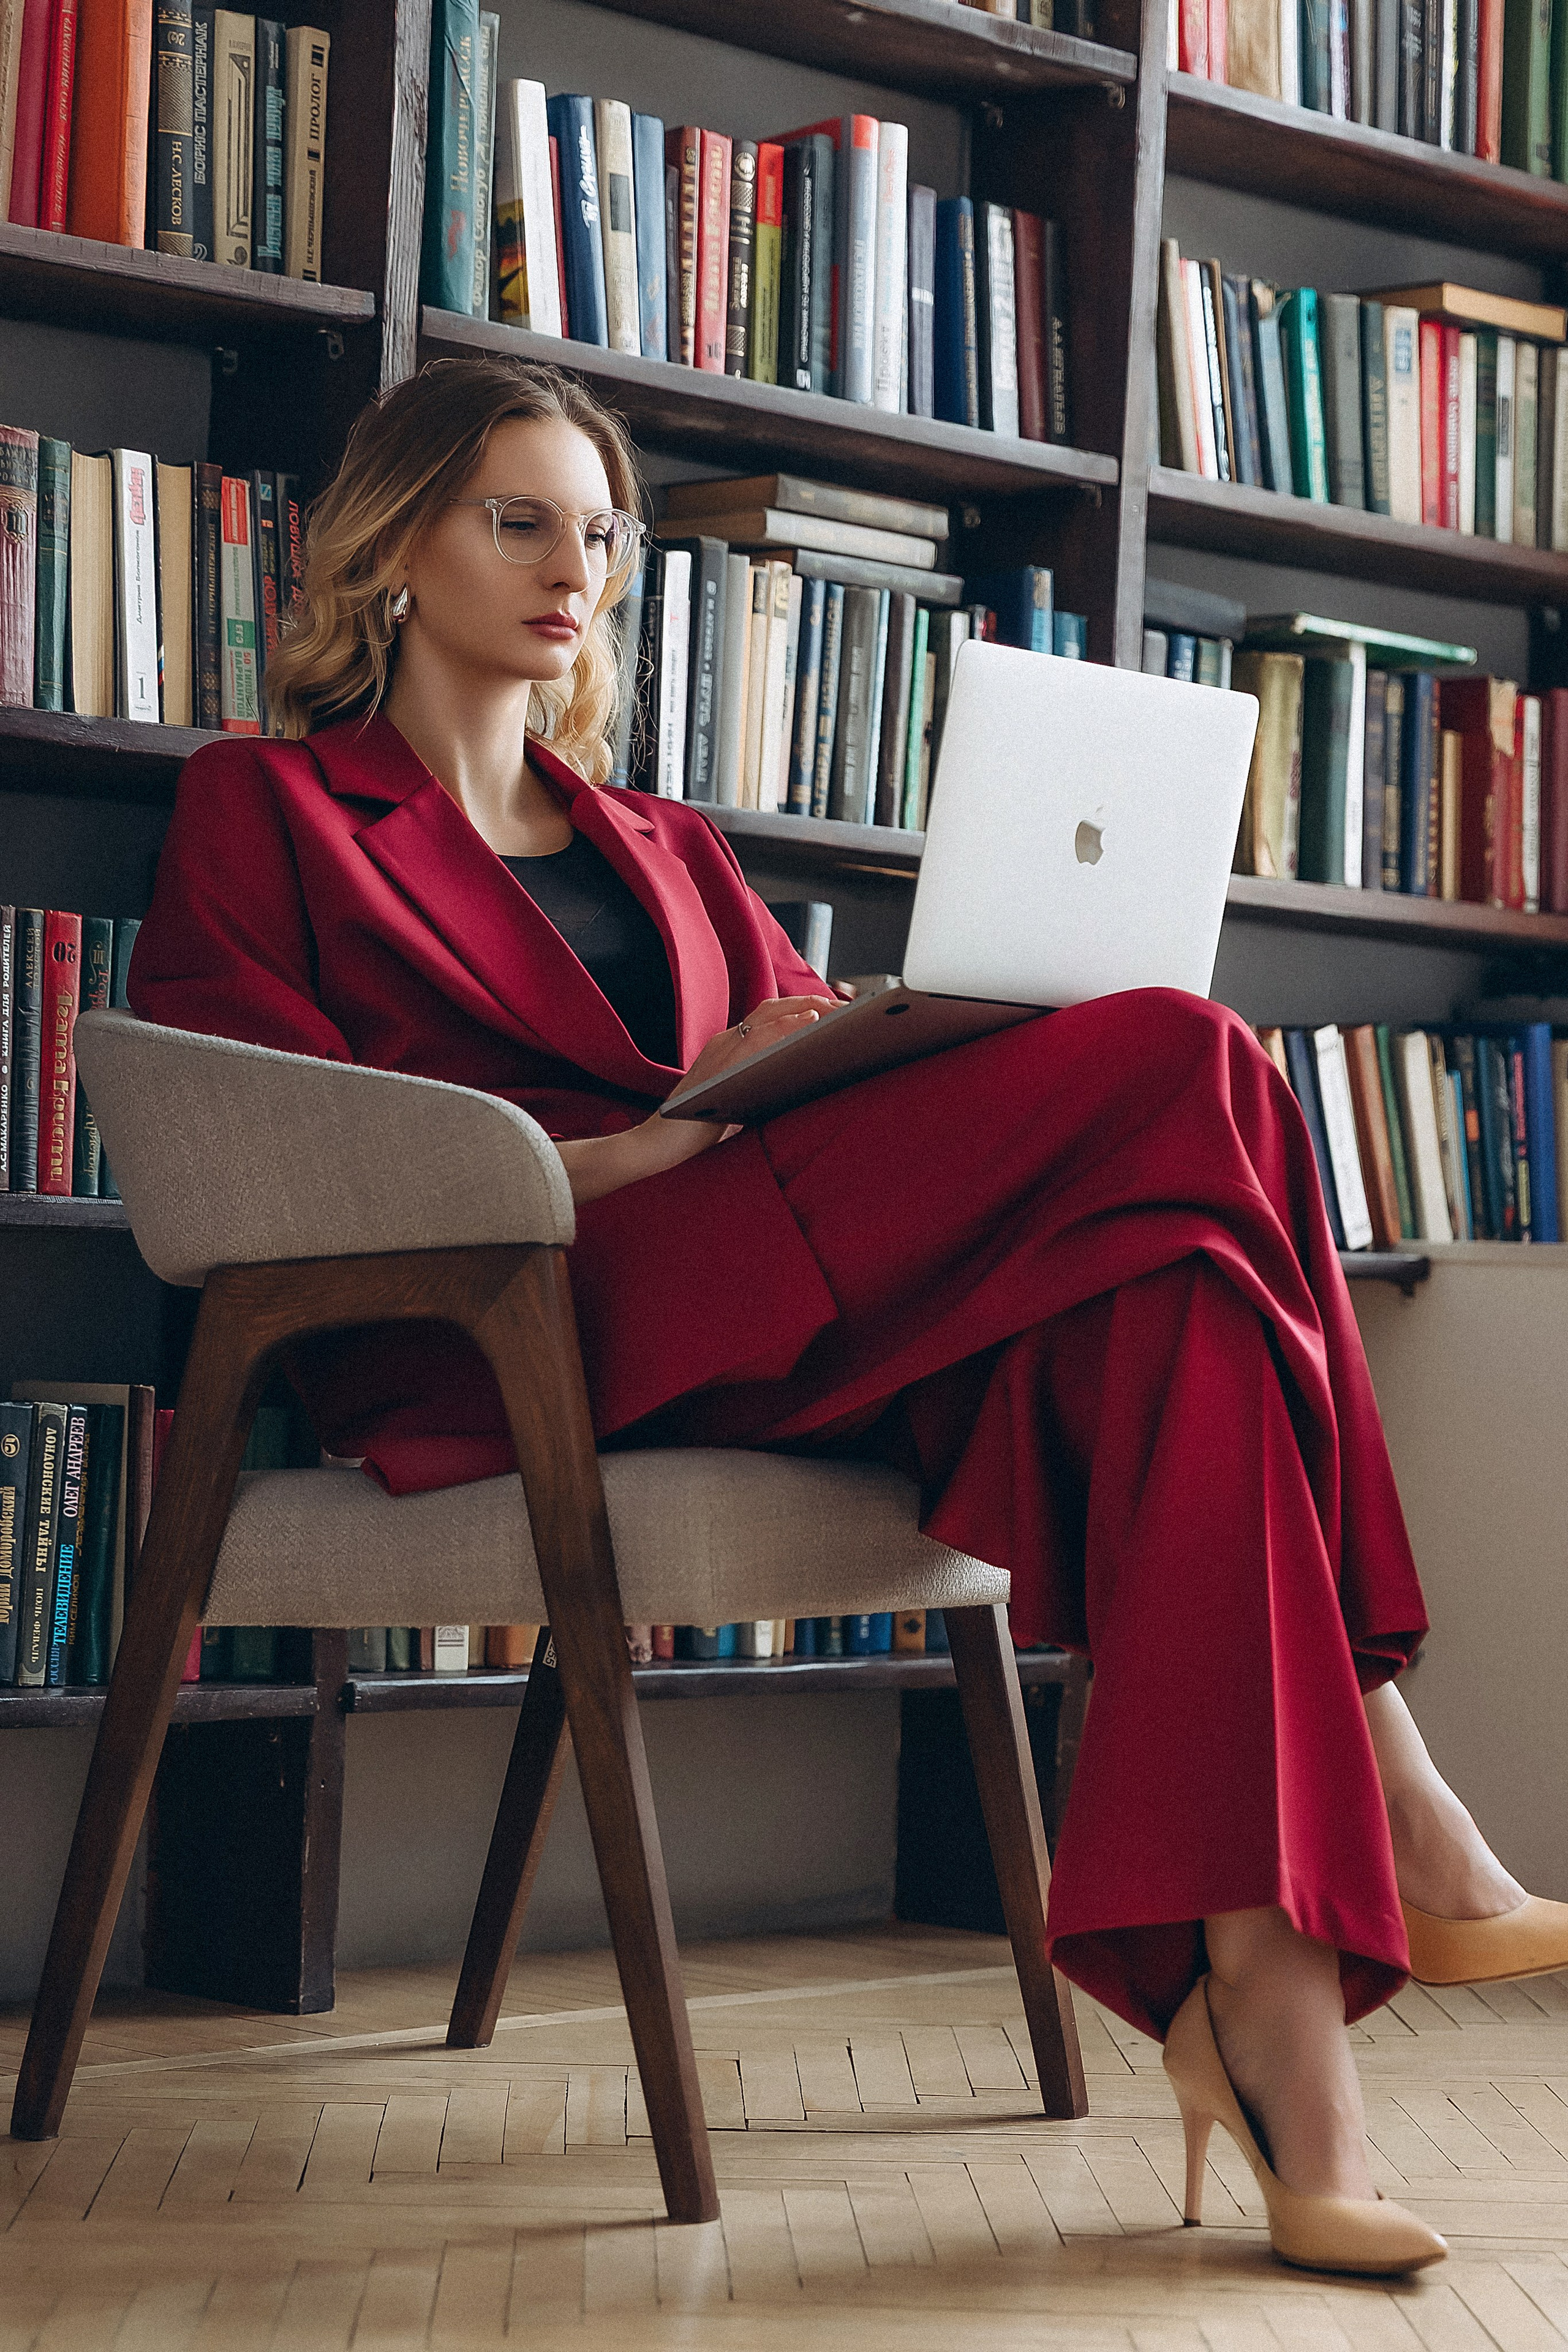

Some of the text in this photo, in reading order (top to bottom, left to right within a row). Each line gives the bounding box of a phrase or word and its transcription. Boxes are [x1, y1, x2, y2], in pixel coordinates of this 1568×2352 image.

[194, 21, 208, 185] БОРИС ПАСТЕРНАК
[309, 72, 322, 140] ПРОЛОГ
[235, 624, 244, 644] ЕГЭ
[243, 652, 252, 664] 50
[2, 924, 12, 988] РОДИТЕЛЕЙ
[25, 928, 35, 989] АЛЕКСЕЙ
[48, 984, 74, 1182] Агата Кристи
[4, 1438, 17, 1454] 5
[66, 1417, 85, 1480] АНДРЕЕВ
[62, 1481, 79, 1518] ОЛЕГ
[31, 1427, 57, 1663] ЛОНДОНСКИЕ ТАЙНЫ ПОЛЬ ФЕВАЛЬ
[53, 1544, 74, 1645] ТЕЛЕВИДЕНИЕ
